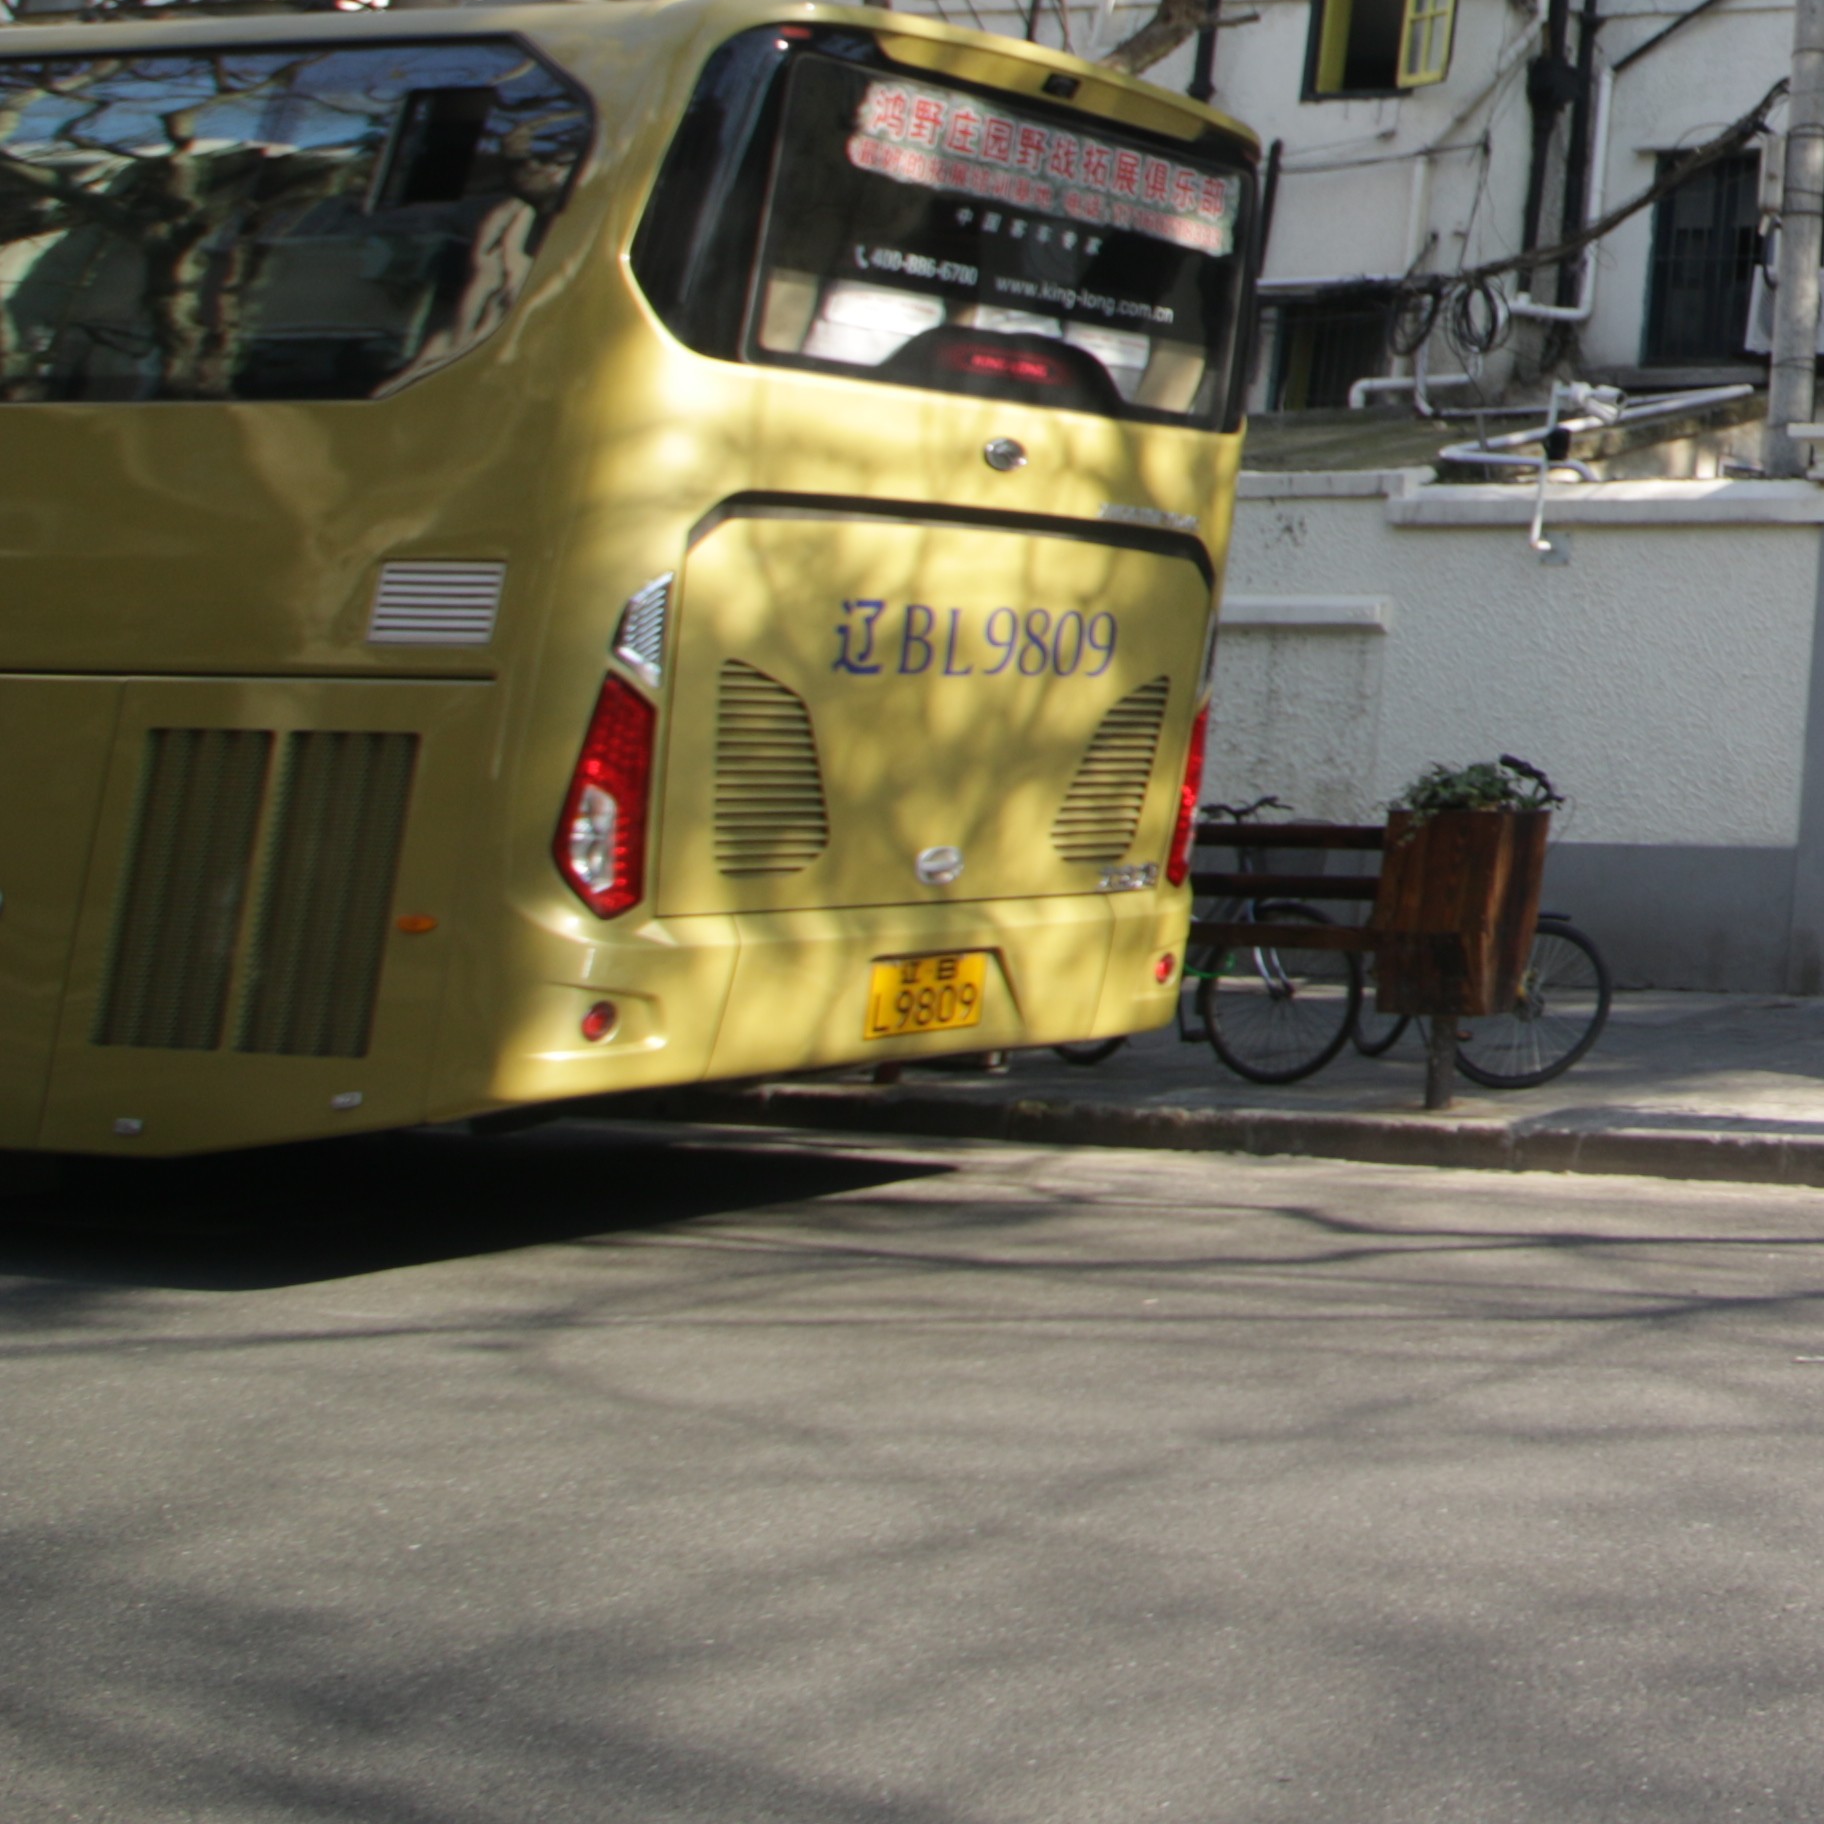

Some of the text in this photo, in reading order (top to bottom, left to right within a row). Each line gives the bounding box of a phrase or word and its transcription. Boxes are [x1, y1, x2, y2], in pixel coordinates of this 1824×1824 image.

[872, 88, 1226, 220] 鸿野庄园野战拓展俱乐部
[995, 275, 1174, 325] www.king-long.com.cn
